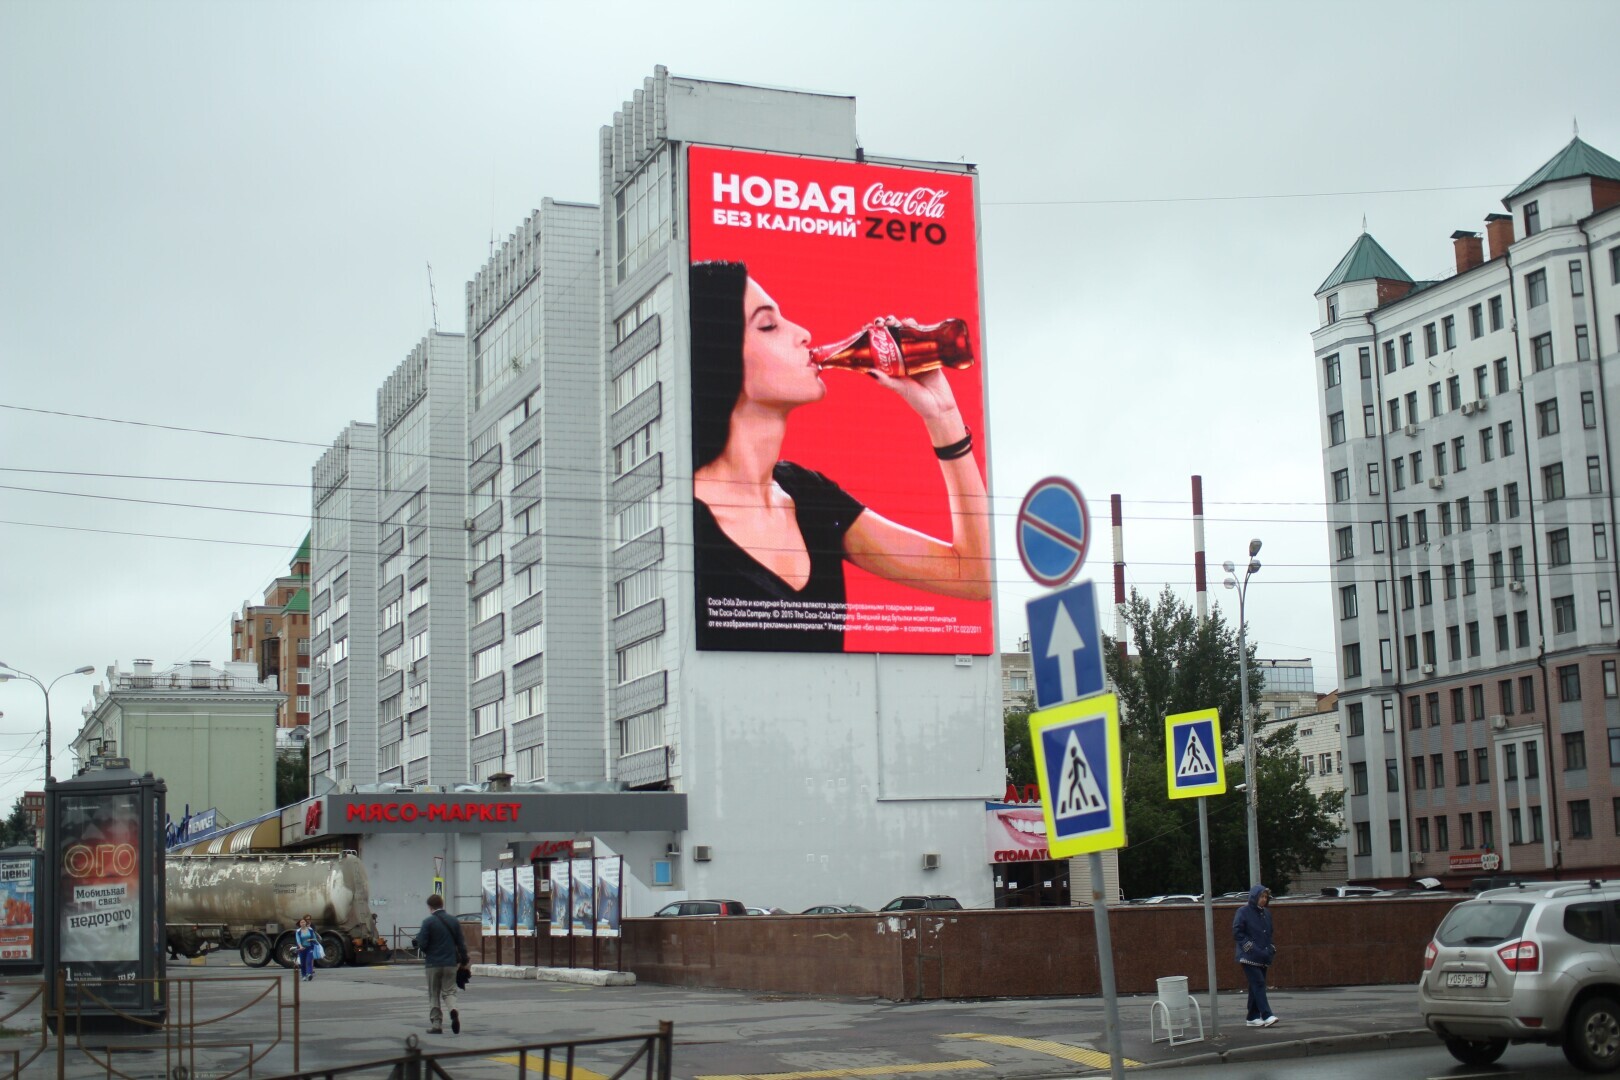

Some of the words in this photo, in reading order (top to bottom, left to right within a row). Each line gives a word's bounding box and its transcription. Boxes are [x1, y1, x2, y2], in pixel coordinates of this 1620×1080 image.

[713, 172, 856, 216] НОВАЯ
[862, 182, 949, 219] Coca-Cola
[713, 209, 752, 228] БЕЗ
[865, 216, 947, 246] zero
[708, 597, 735, 607] Coca-Cola
[736, 598, 748, 607] Zero
[753, 600, 780, 609] контурная
[781, 599, 802, 609] бутылка
[802, 601, 826, 609] являются
[708, 608, 719, 616] The
[719, 608, 746, 618] Coca-Cola
[781, 610, 794, 618] 2015
[794, 610, 804, 618] The
[804, 610, 831, 619] Coca-Cola
[857, 612, 880, 621] Внешний
[881, 614, 892, 622] вид
[892, 613, 912, 622] бутылки
[723, 619, 758, 630] изображения
[764, 622, 792, 630] рекламных
[828, 622, 862, 632] Утверждение
[346, 803, 522, 822] МЯСО-МАРКЕТ
[64, 843, 136, 877] ОГО
[2, 869, 30, 880] цены
[76, 887, 126, 899] Мобильная
[98, 897, 121, 906] связь
[70, 908, 132, 928] недорого
